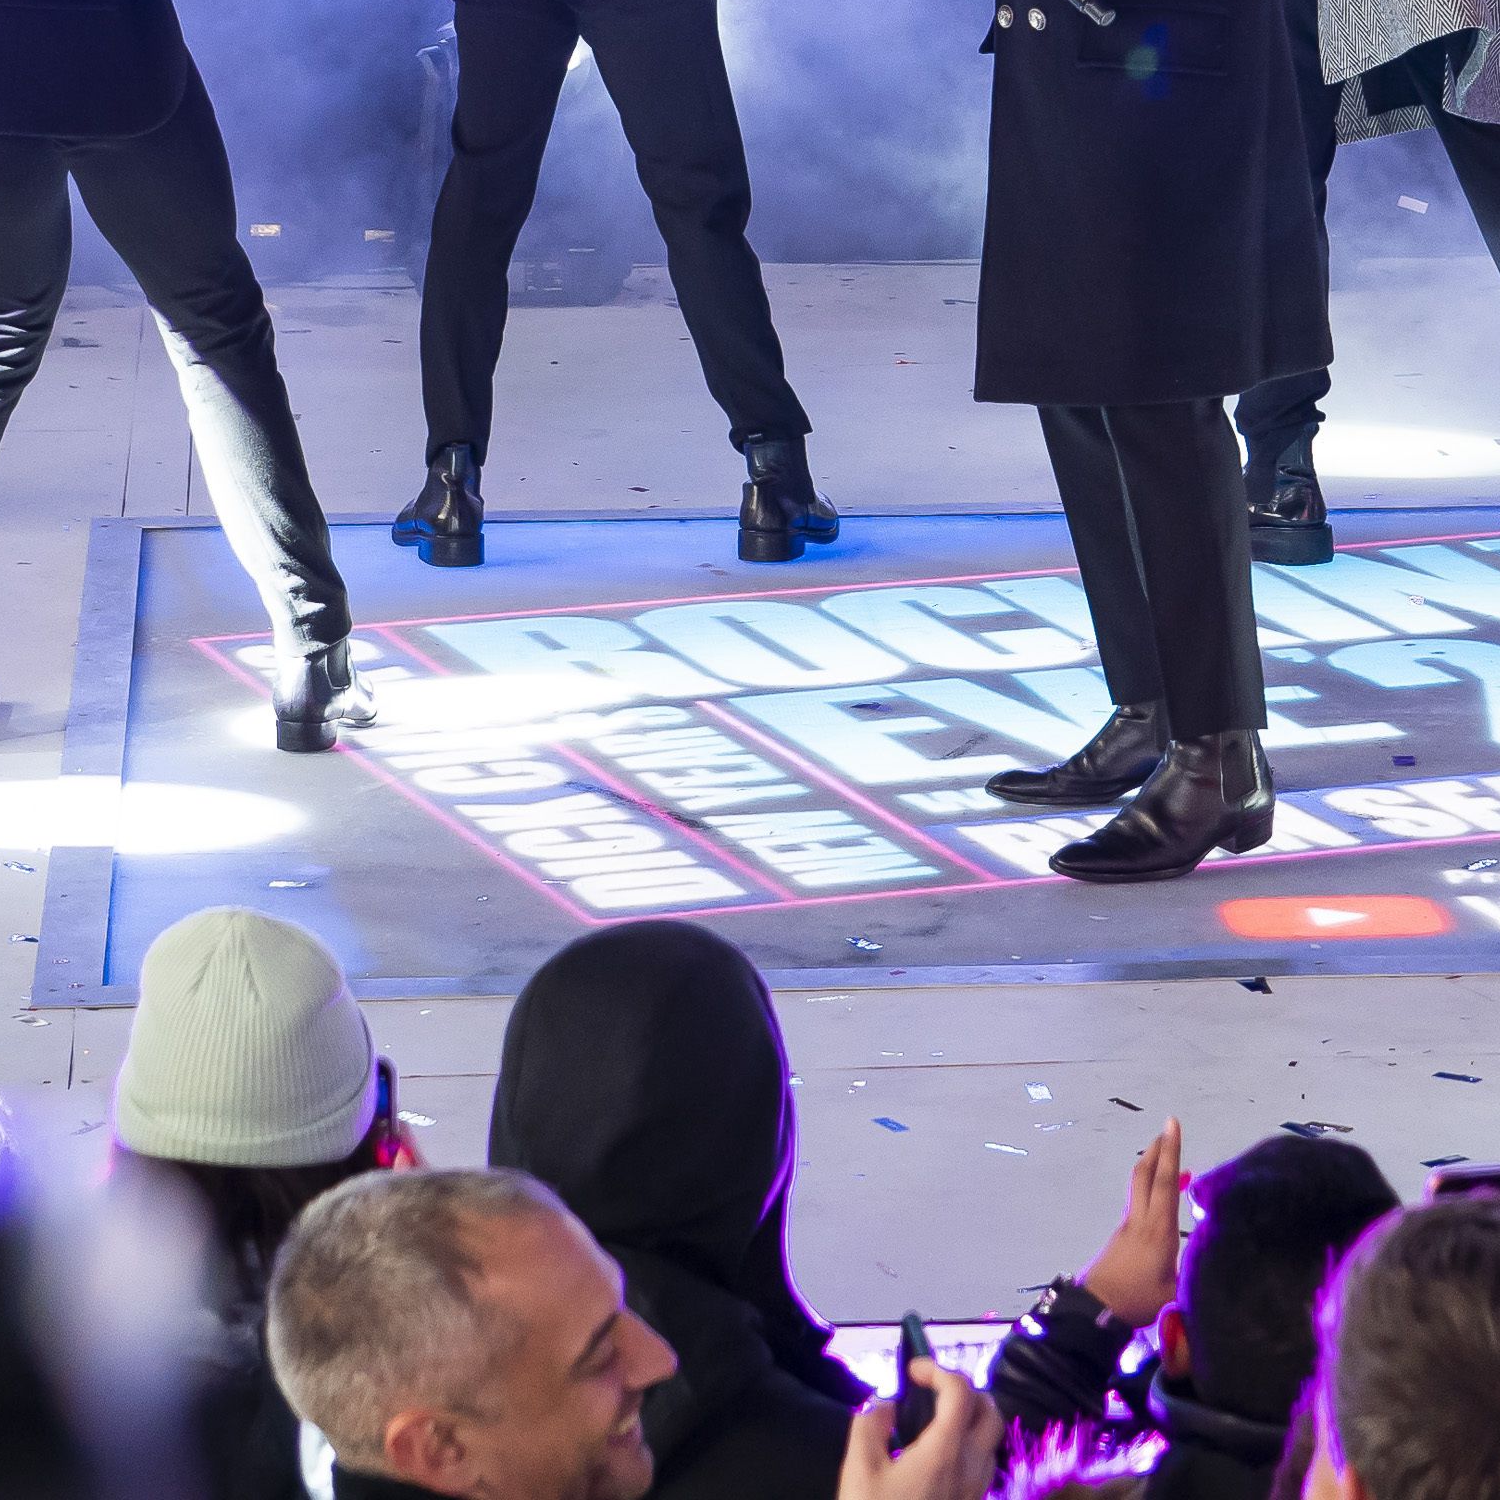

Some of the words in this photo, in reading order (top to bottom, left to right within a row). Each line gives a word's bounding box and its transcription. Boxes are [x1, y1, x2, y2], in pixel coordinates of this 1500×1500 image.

[548, 704, 812, 813] YEARS
[453, 792, 748, 910] DICK
[703, 809, 942, 888] NEW
